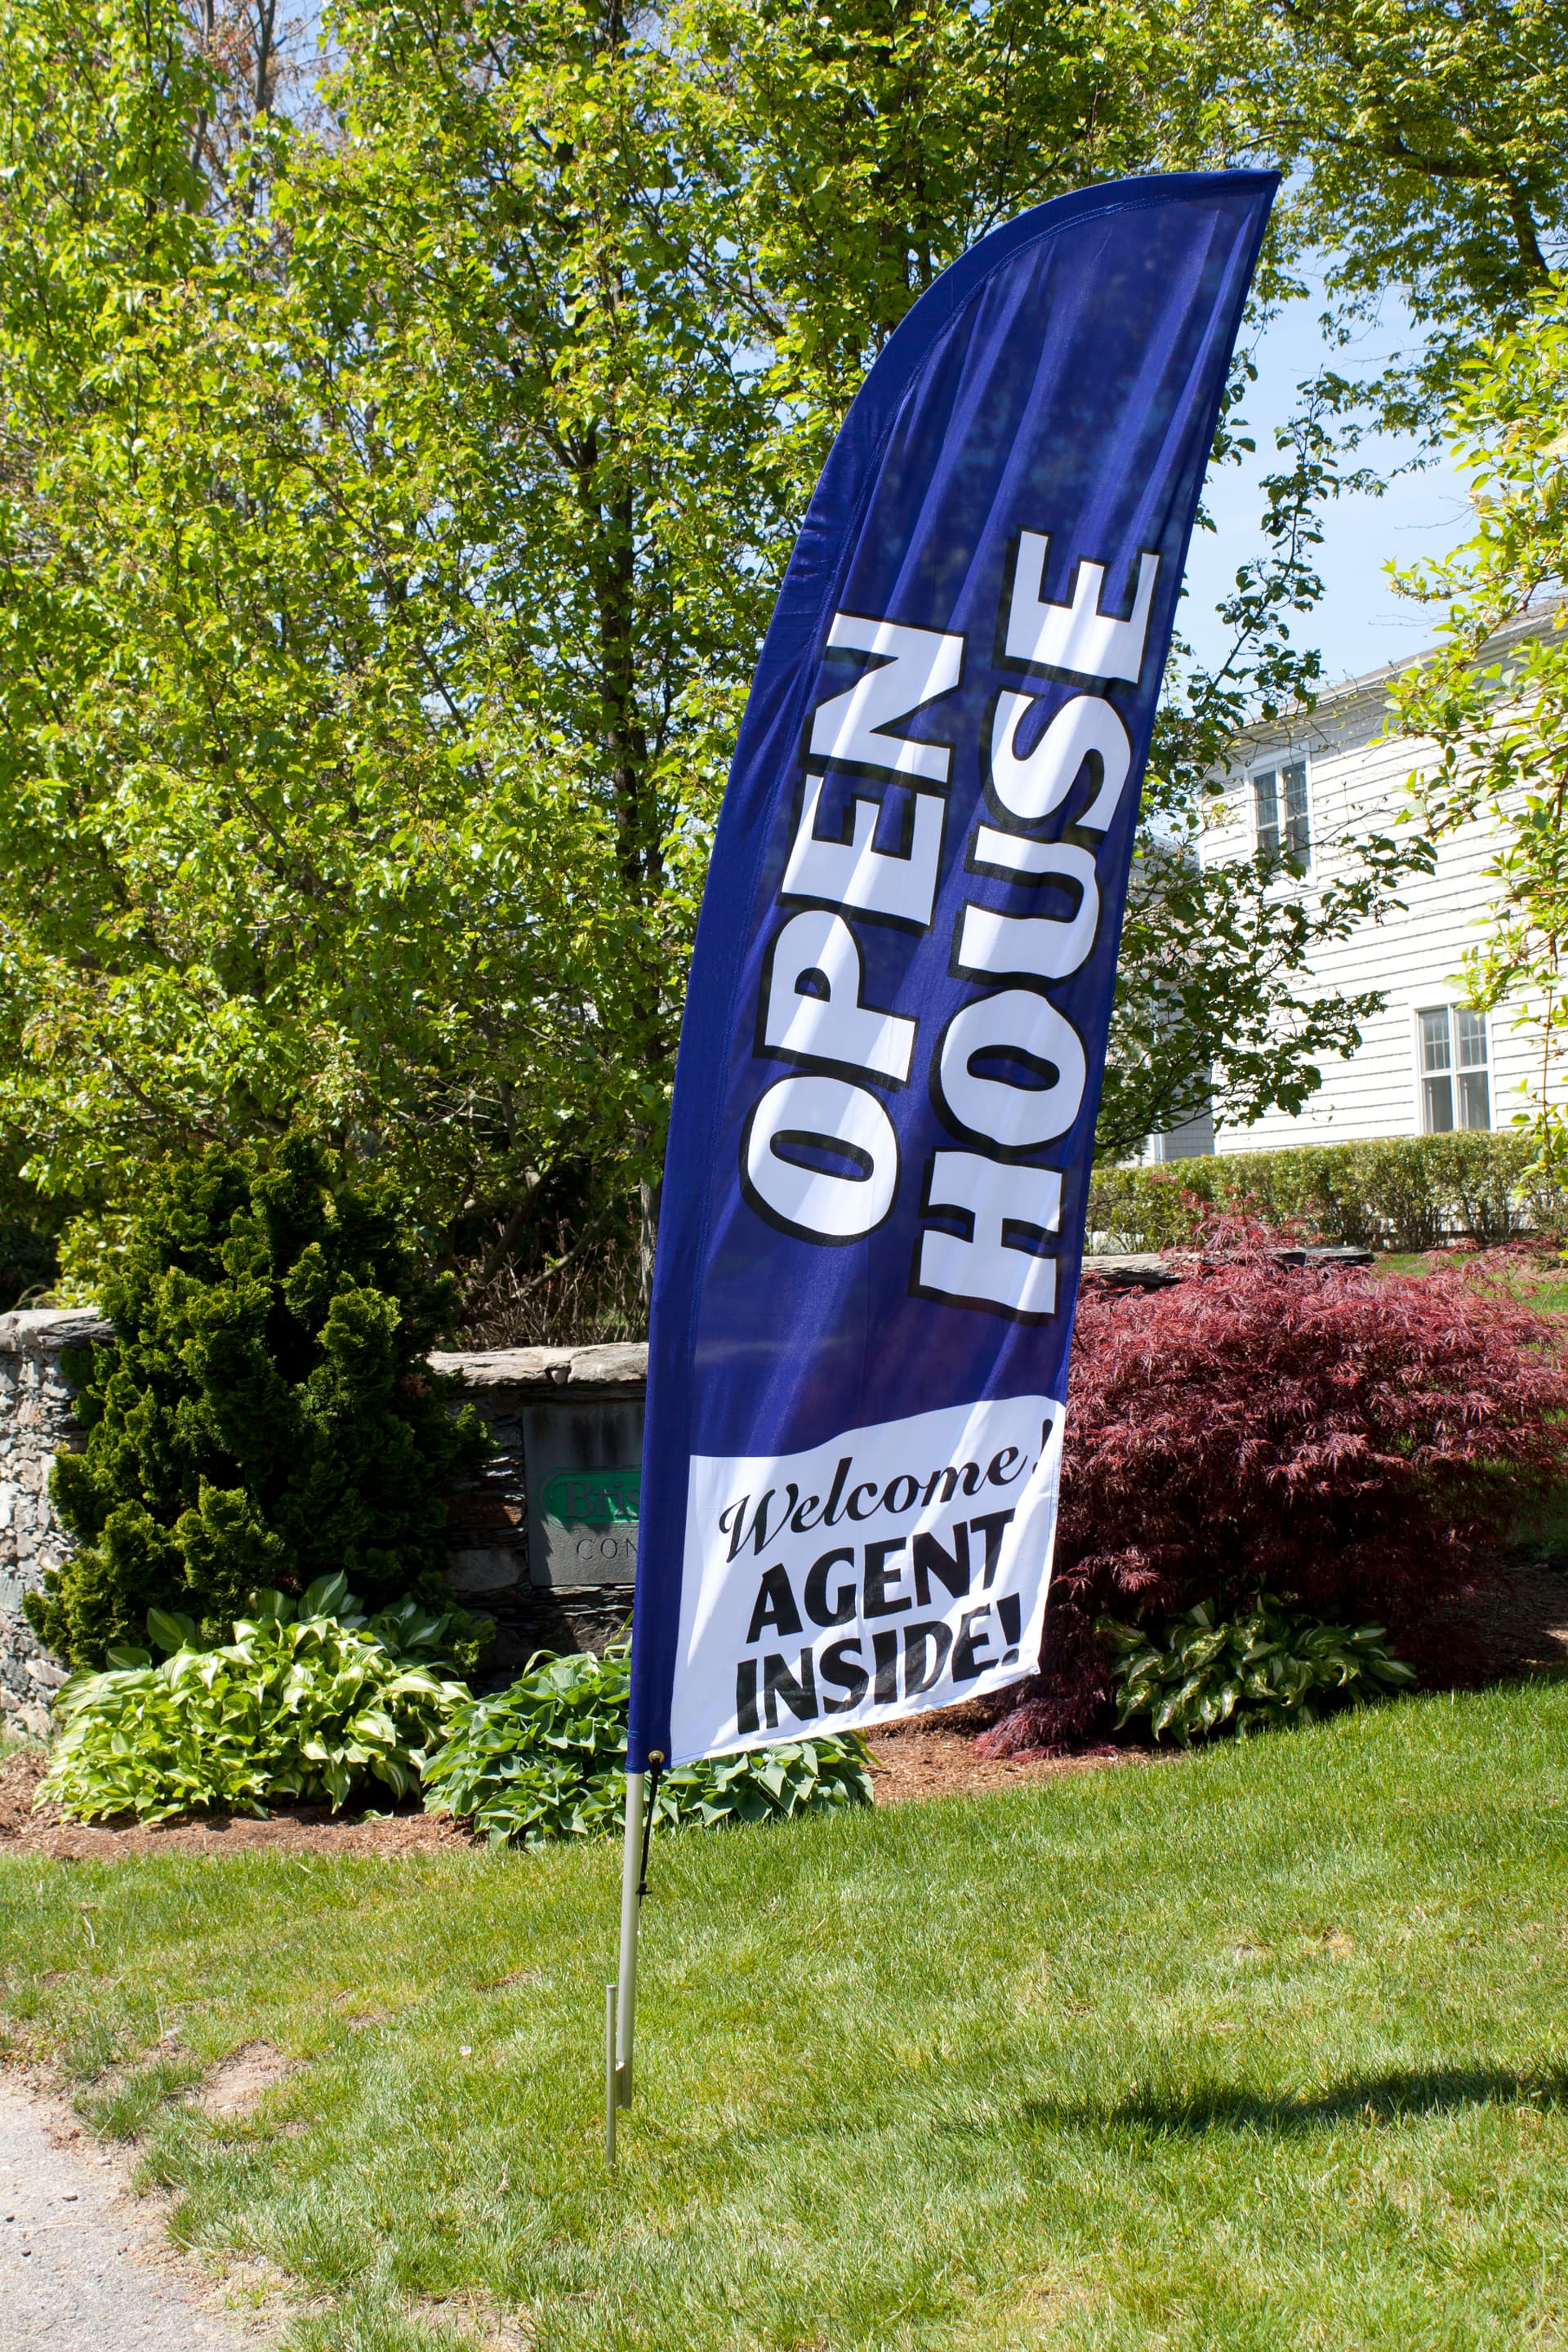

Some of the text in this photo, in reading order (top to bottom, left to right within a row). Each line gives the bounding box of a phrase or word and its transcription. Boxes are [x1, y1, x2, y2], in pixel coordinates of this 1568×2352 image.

[742, 612, 967, 1245] OPEN
[910, 528, 1161, 1325] HOUSE
[719, 1419, 1054, 1563] Welcome!
[746, 1508, 1015, 1644] AGENT
[736, 1592, 1021, 1735] INSIDE!
